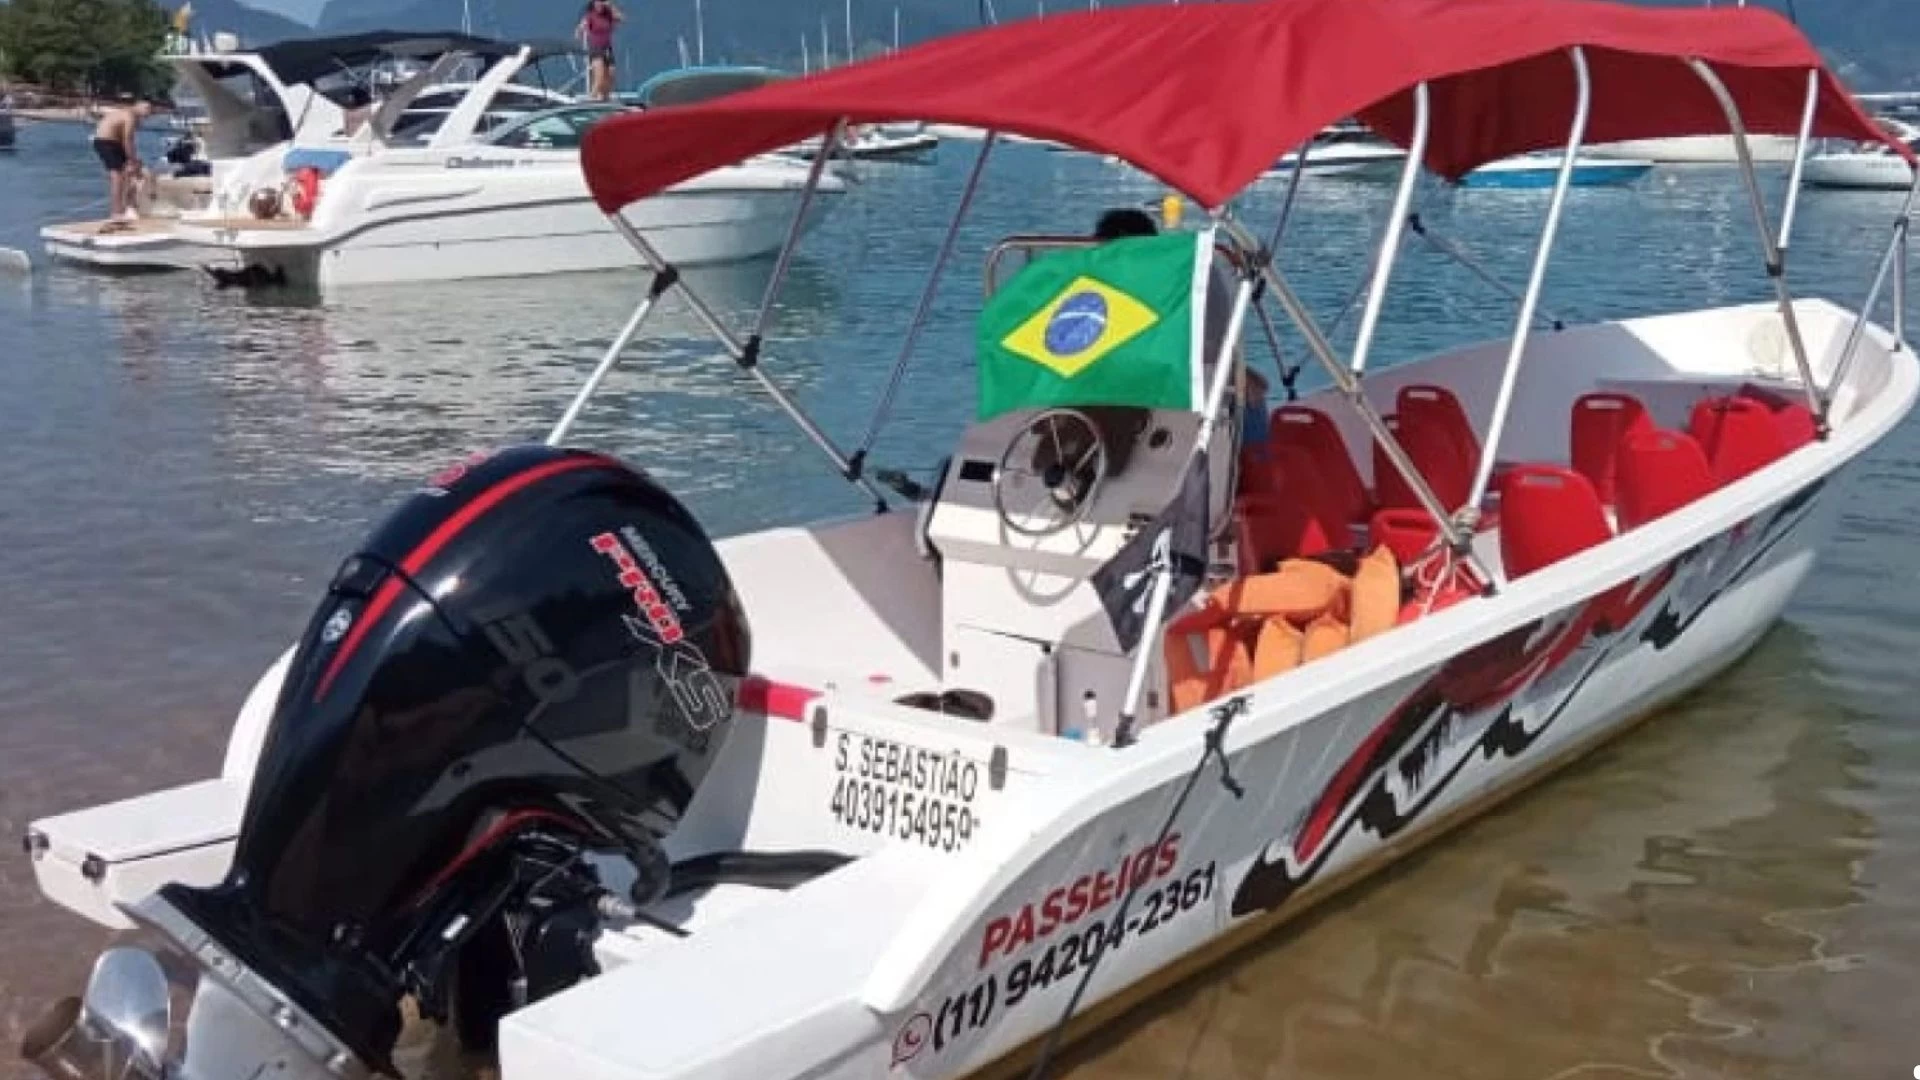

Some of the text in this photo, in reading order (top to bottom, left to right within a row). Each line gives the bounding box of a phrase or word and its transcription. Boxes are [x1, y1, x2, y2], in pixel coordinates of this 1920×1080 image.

[835, 732, 978, 802] S. SEBASTIÃO
[933, 860, 1216, 1051] (11) 94204-2361
[978, 831, 1181, 969] PASSEIOS
